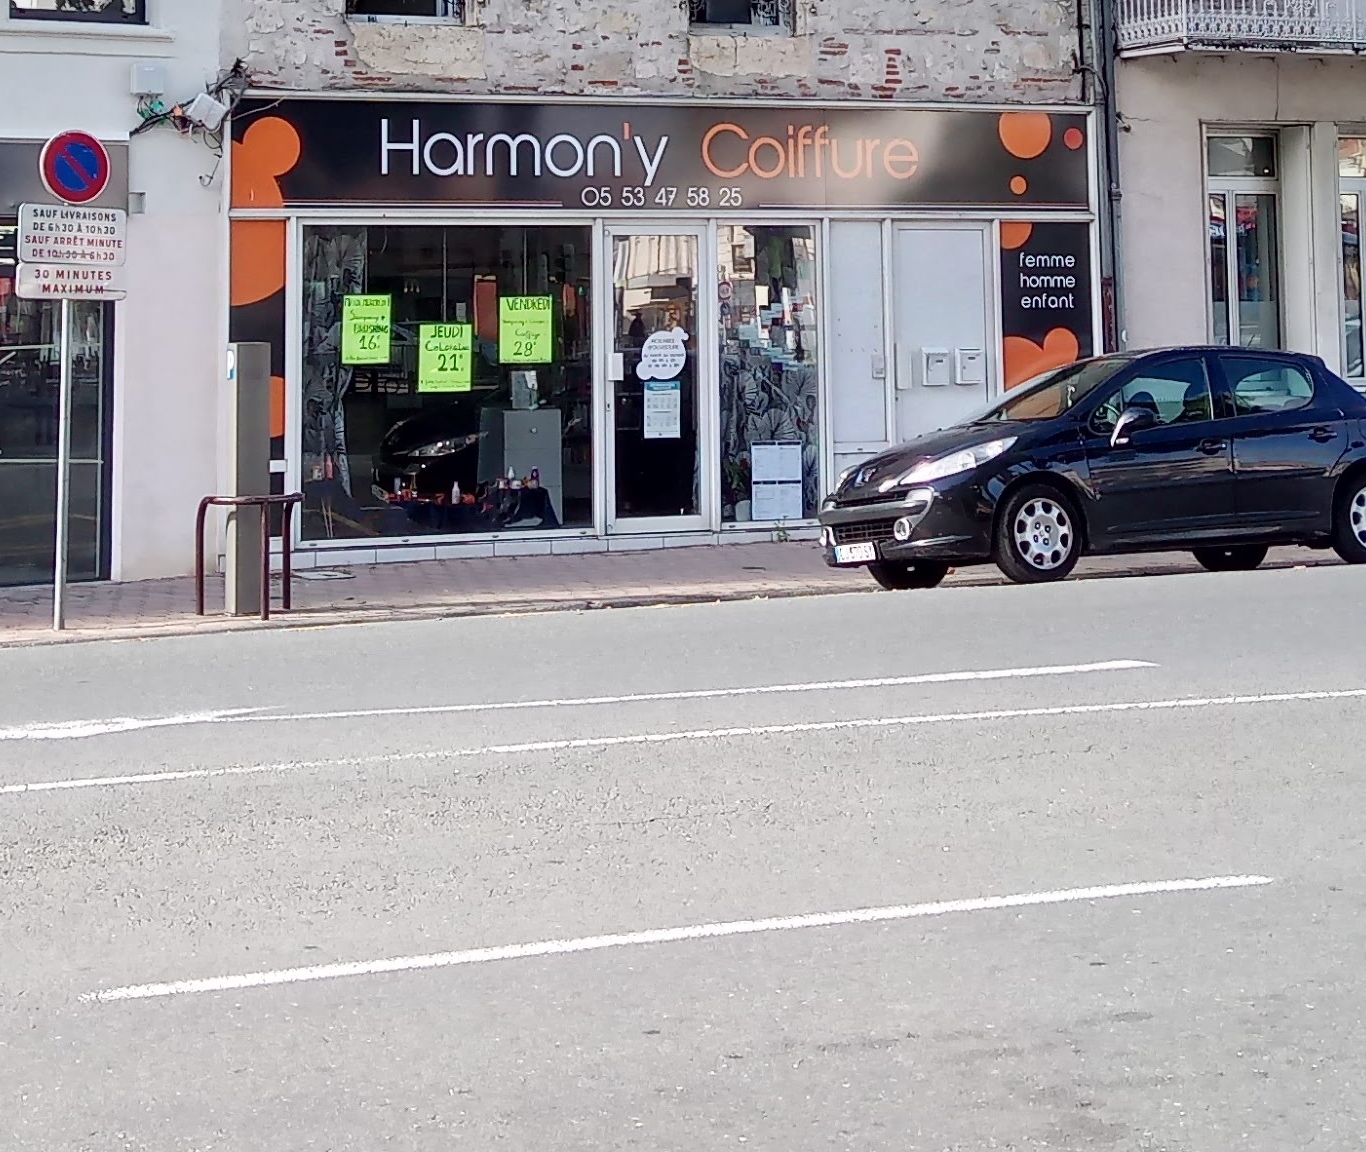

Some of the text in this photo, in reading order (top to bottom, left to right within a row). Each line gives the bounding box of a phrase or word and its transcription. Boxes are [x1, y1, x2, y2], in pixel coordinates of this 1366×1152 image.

[381, 118, 920, 186] Harmon'y Coiffure
[581, 187, 742, 207] 05 53 47 58 25
[33, 209, 117, 222] SAUF LIVRAISONS
[33, 222, 45, 231] DE
[25, 234, 123, 248] SAUF ARRÊT MINUTE
[32, 249, 45, 258] DE
[1019, 252, 1075, 267] femme
[35, 269, 112, 280] 30 MINUTES
[1020, 272, 1075, 288] homme
[42, 284, 104, 294] MAXIMUM
[1020, 293, 1075, 308] enfant
[430, 326, 463, 338] JEUDI
